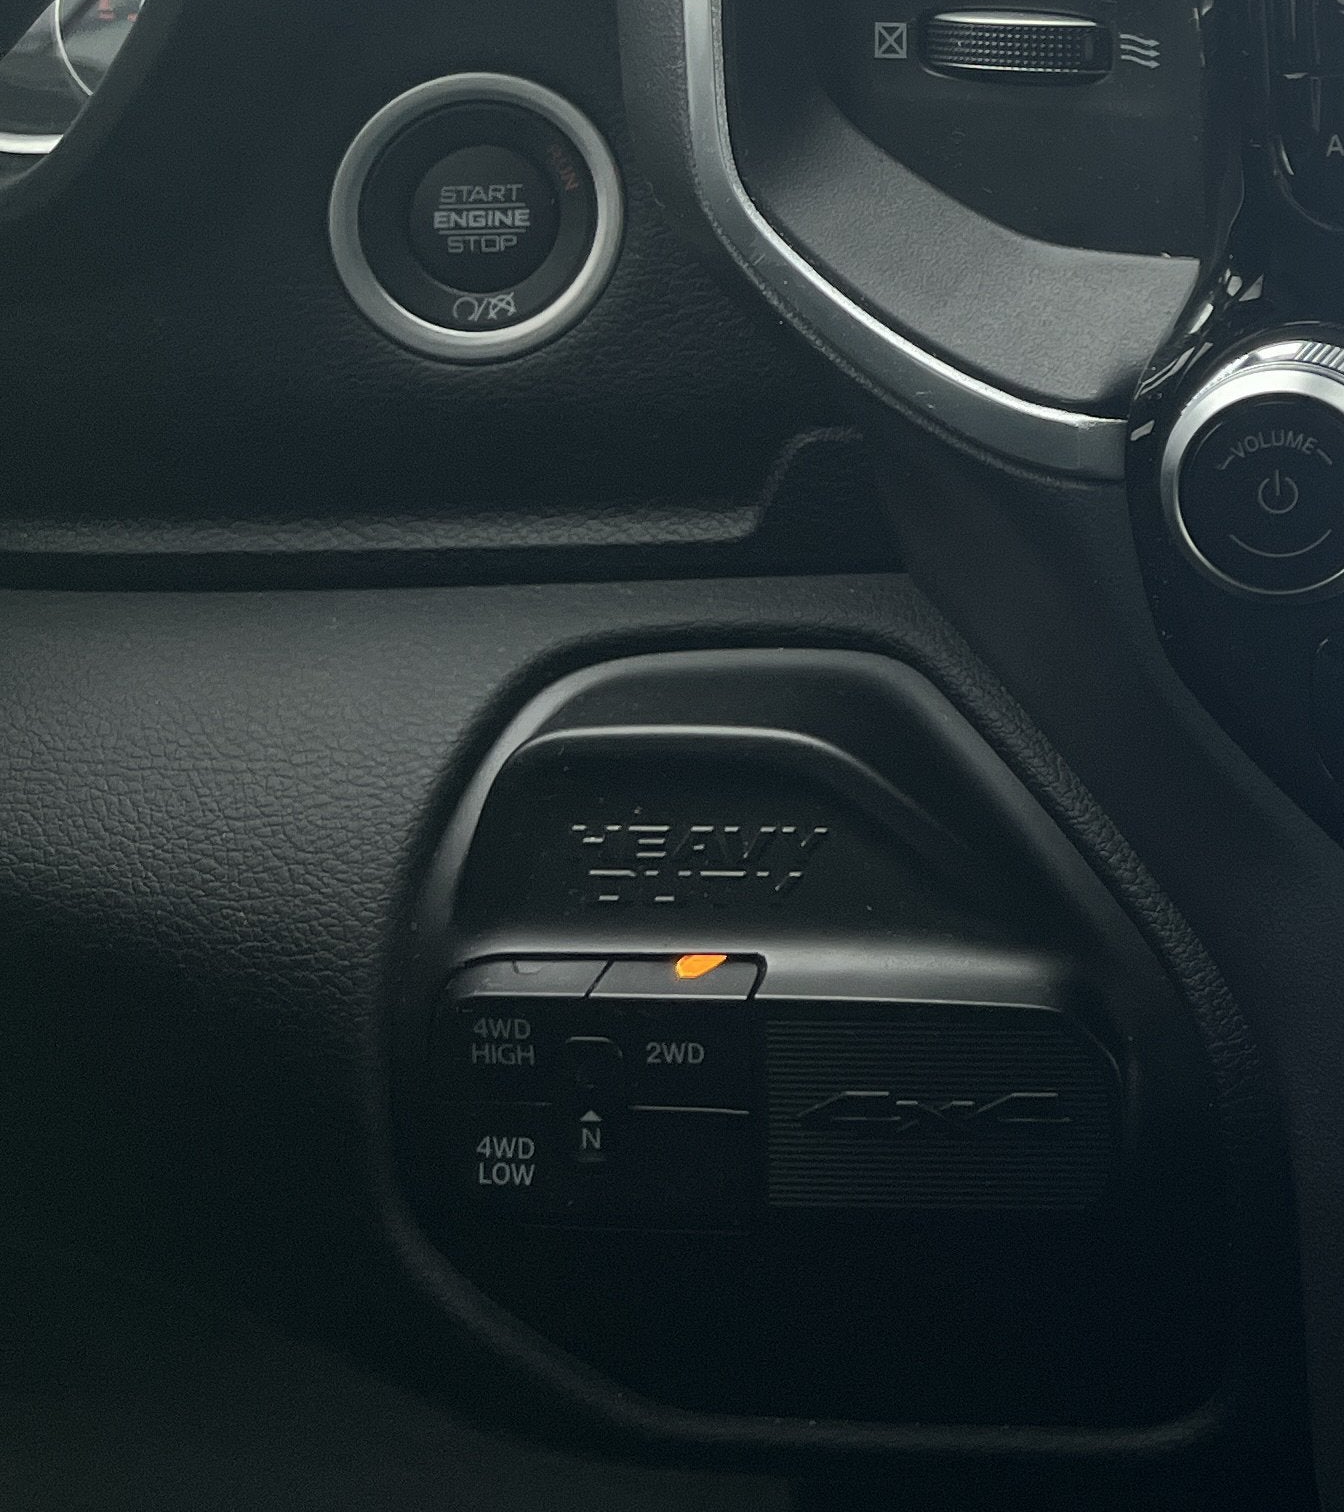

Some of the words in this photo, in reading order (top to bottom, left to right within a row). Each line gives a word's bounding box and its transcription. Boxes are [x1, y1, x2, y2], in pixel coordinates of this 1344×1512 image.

[440, 184, 522, 202] START
[434, 209, 530, 230] ENGINE
[448, 236, 518, 253] STOP
[1230, 430, 1317, 459] VOLUME
[473, 1020, 531, 1039] 4WD
[472, 1045, 534, 1066] HIGH
[646, 1043, 704, 1063] 2WD
[477, 1137, 534, 1158] 4WD
[581, 1128, 600, 1148] N
[479, 1164, 534, 1185] LOW
